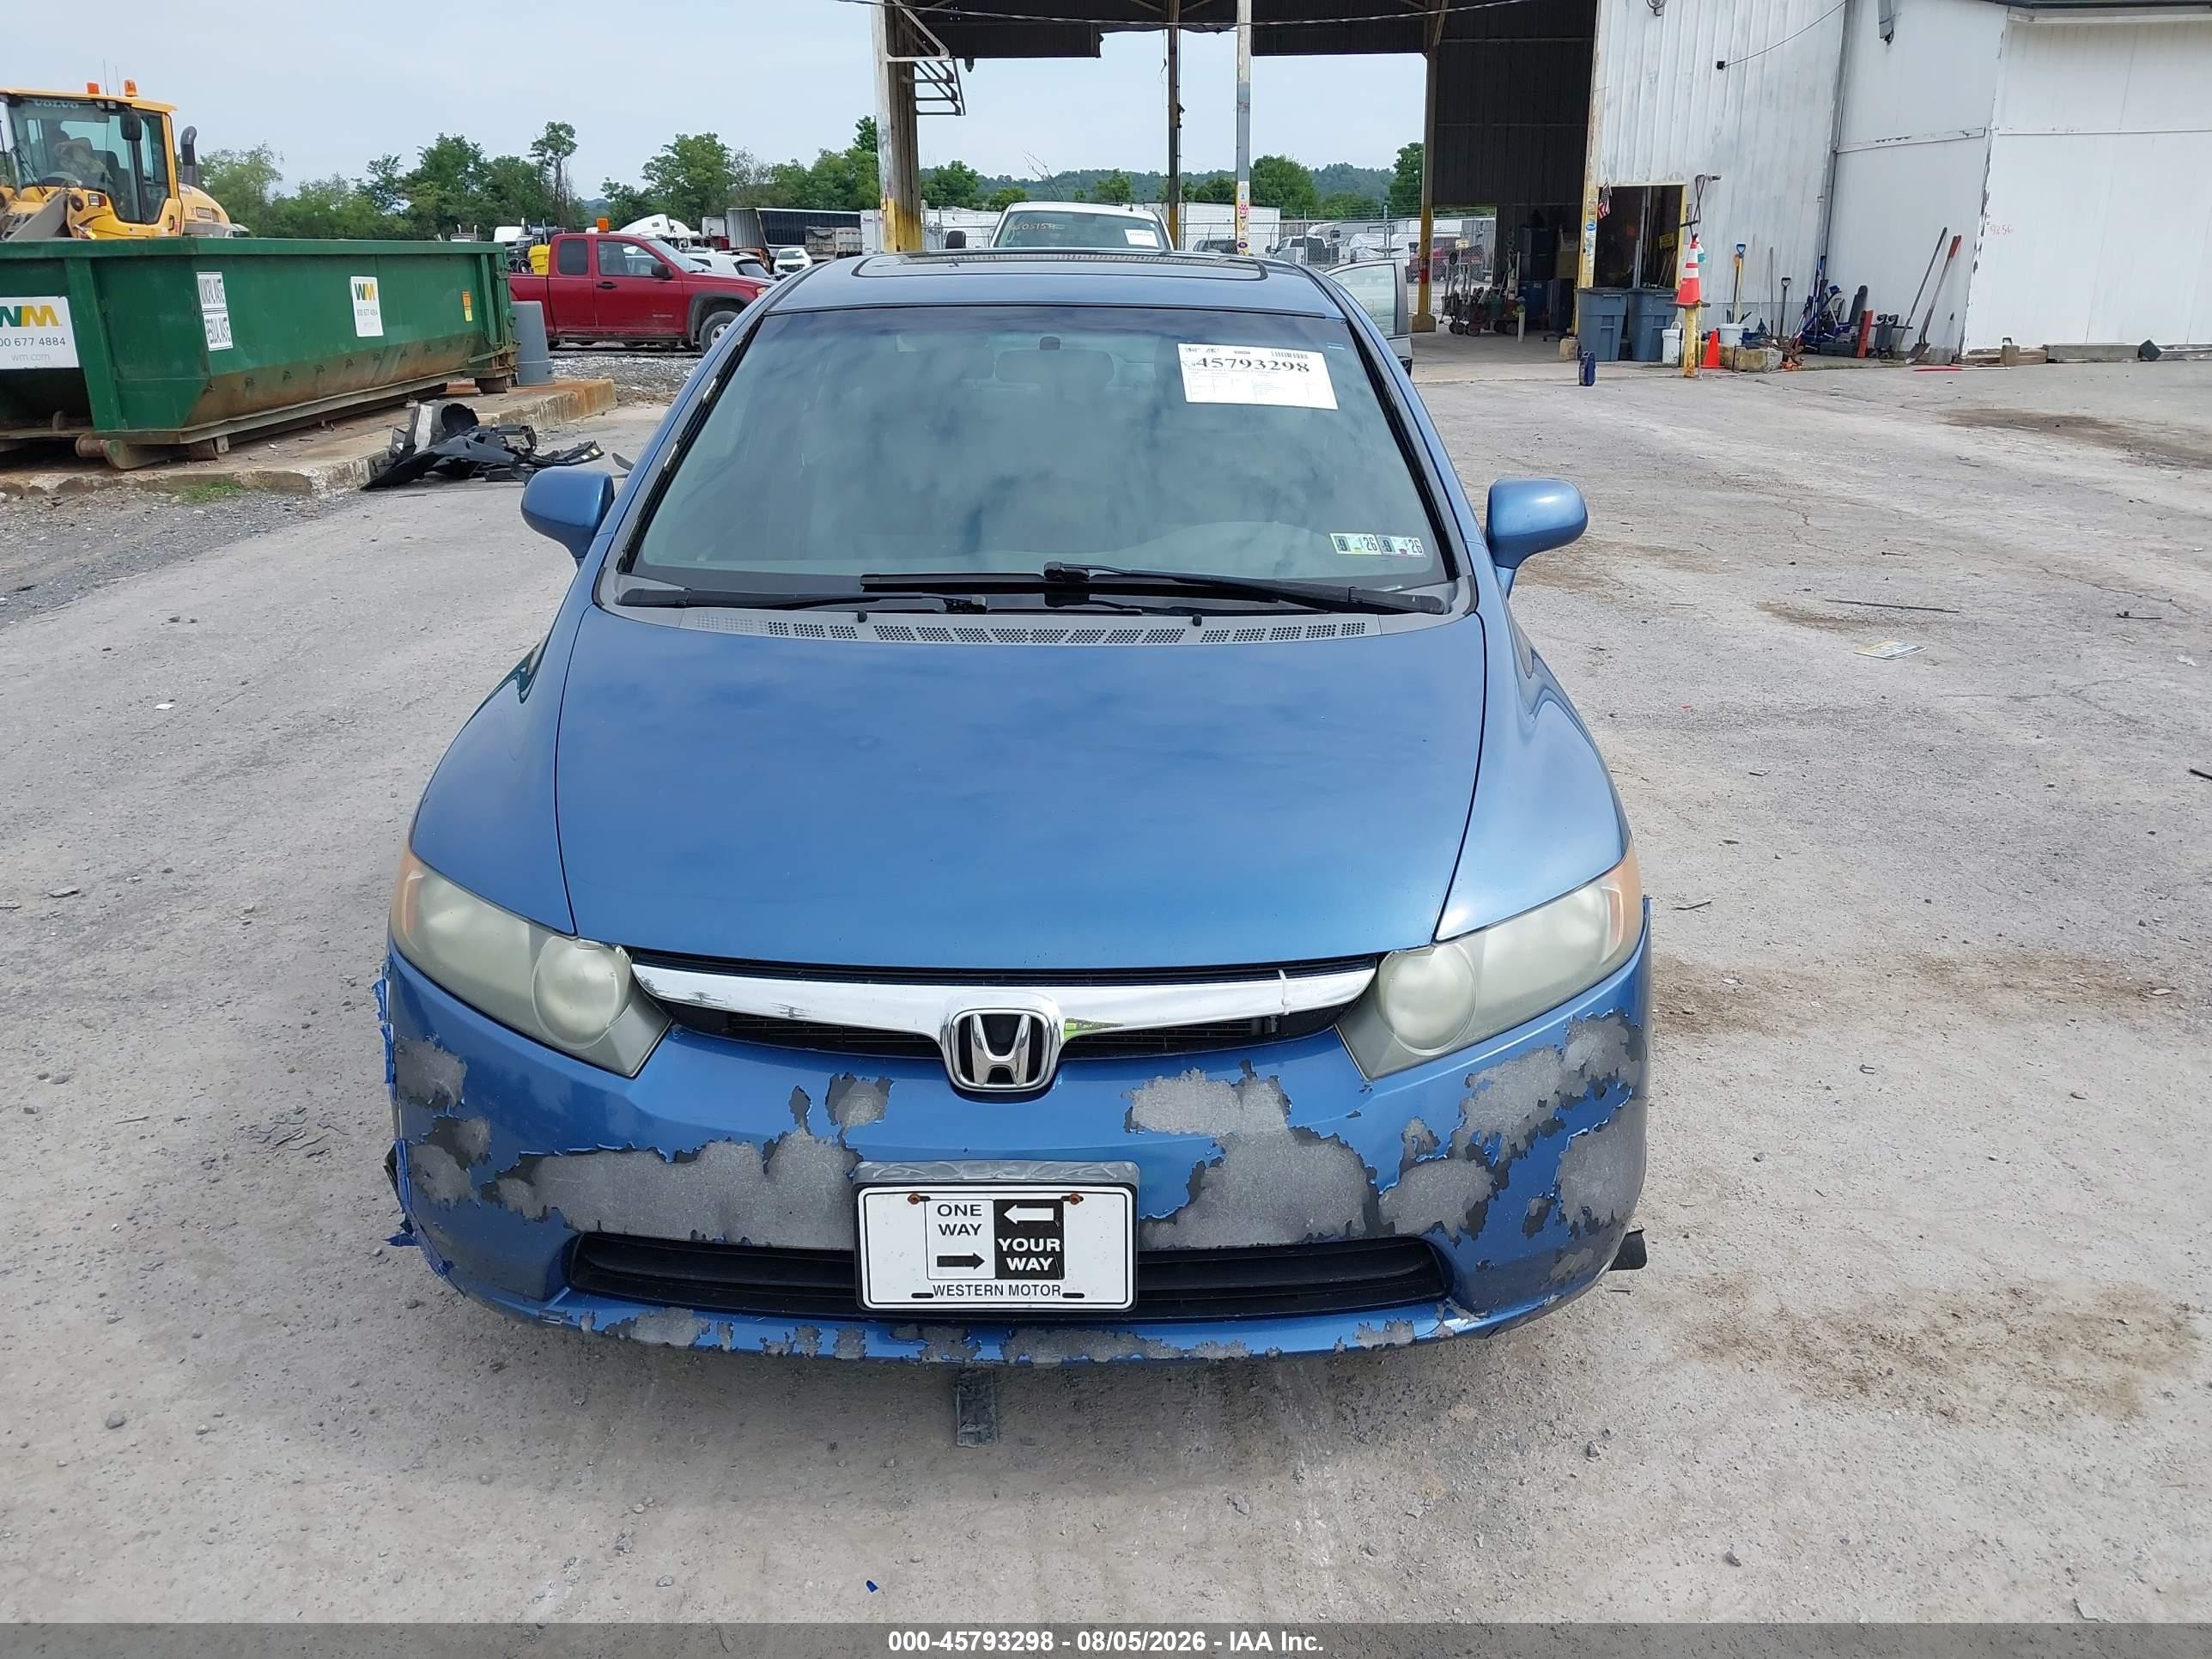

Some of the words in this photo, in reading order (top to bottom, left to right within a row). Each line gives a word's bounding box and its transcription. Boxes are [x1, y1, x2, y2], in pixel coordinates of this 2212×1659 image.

[34, 99, 79, 109] VOLVO
[354, 283, 376, 301] WM
[0, 305, 59, 327] WM
[14, 337, 34, 347] 677
[39, 337, 66, 346] 4884
[1196, 357, 1310, 373] 45793298
[937, 1204, 982, 1217] ONE
[938, 1223, 982, 1237] WAY
[997, 1237, 1060, 1252] YOUR
[1006, 1257, 1054, 1271] WAY
[933, 1284, 1004, 1297] WESTERN
[1008, 1284, 1061, 1297] MOTOR
